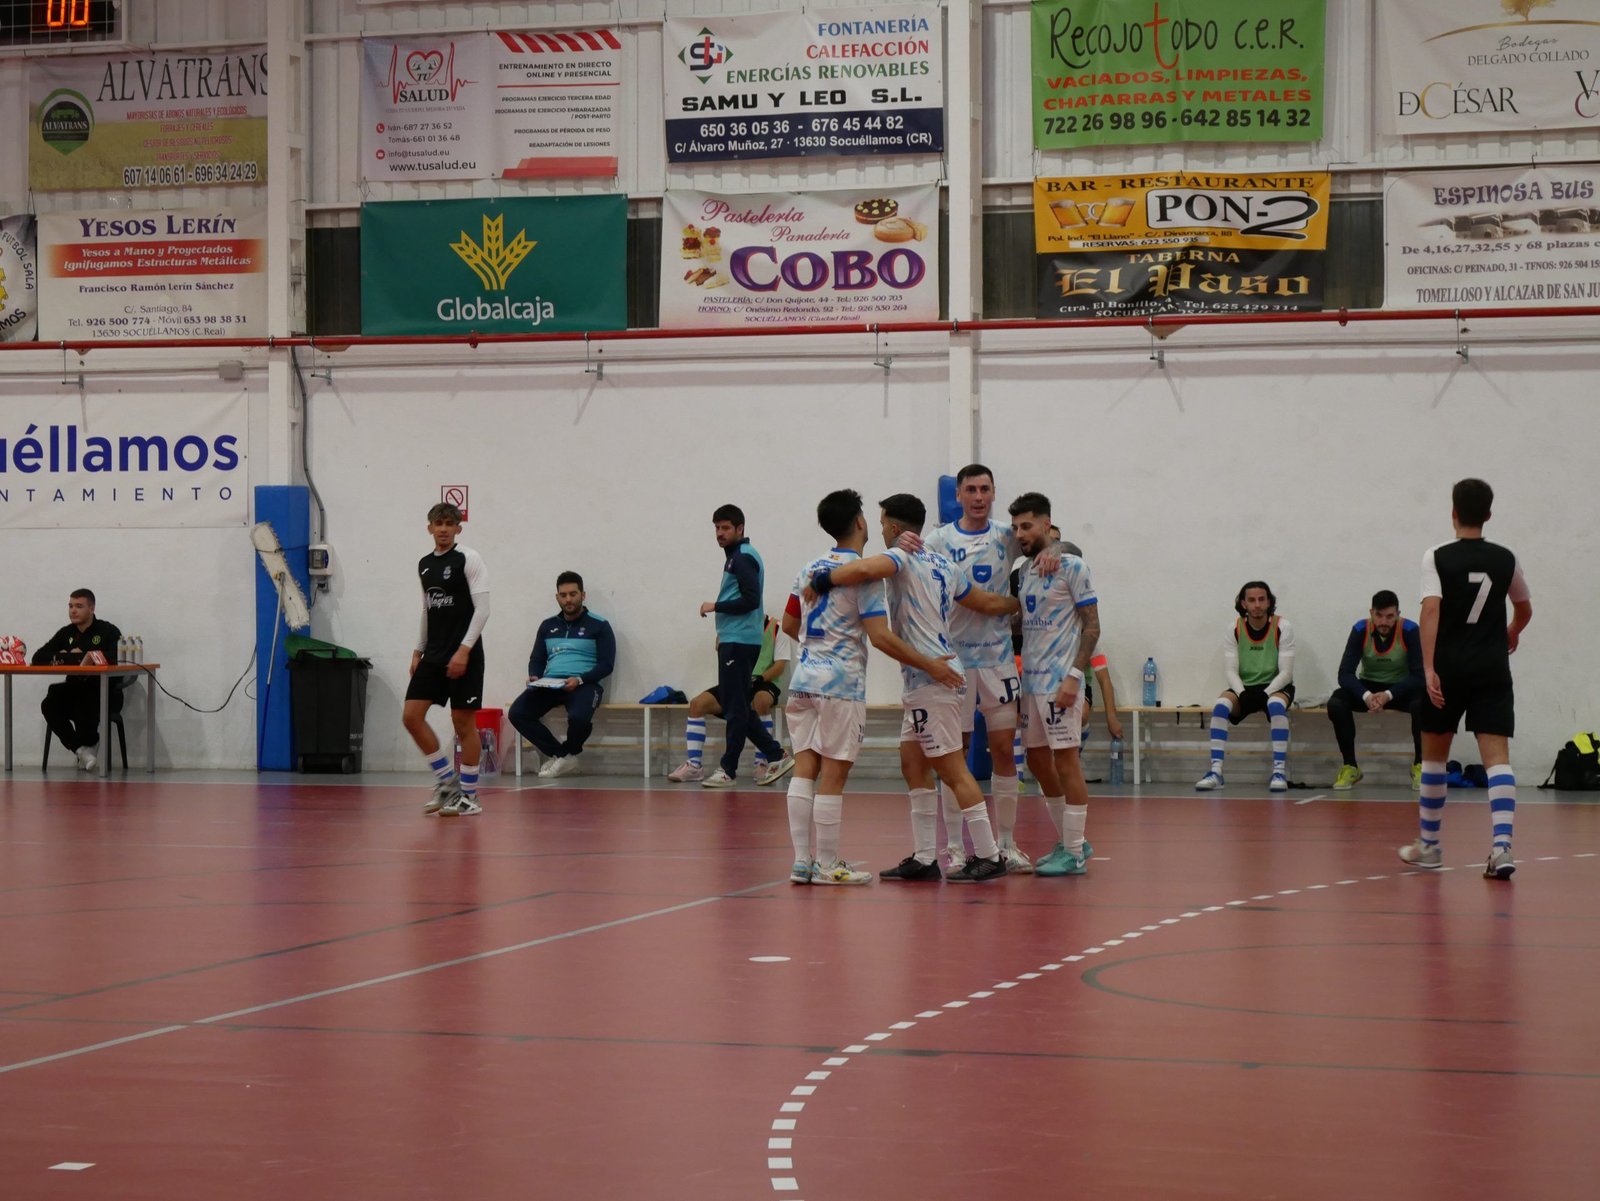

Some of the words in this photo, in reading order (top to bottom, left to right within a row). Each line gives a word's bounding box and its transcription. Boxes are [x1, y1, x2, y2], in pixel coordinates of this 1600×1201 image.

[818, 14, 929, 37] FONTANERÍA
[806, 37, 929, 59] CALEFACCIÓN
[1496, 35, 1559, 51] Bodegas
[1468, 53, 1526, 66] DELGADO
[1529, 50, 1590, 63] COLLADO
[417, 72, 432, 82] TU
[726, 62, 811, 84] ENERGÍAS
[818, 60, 929, 79] RENOVABLES
[1047, 70, 1170, 90] VACIADOS,
[1175, 68, 1309, 82] LIMPIEZAS,
[399, 88, 450, 103] SALUD
[682, 93, 758, 112] SAMU
[768, 92, 785, 108] Y
[799, 89, 847, 106] LEO
[871, 87, 923, 104] S.L.
[1043, 91, 1178, 111] CHATARRAS
[1181, 90, 1196, 102] Y
[1202, 89, 1312, 103] METALES
[44, 120, 88, 130] ALVATRANS
[443, 122, 453, 130] 52
[700, 123, 725, 137] 650
[730, 121, 747, 136] 36
[751, 121, 769, 135] 05
[773, 120, 790, 134] 36
[811, 118, 839, 132] 676
[843, 117, 861, 131] 45
[864, 116, 882, 130] 44
[886, 115, 904, 129] 82
[1043, 115, 1077, 135] 722
[1082, 113, 1104, 131] 26
[1109, 111, 1136, 130] 98
[1141, 110, 1167, 129] 96
[1180, 109, 1221, 128] 642
[1226, 109, 1251, 127] 85
[1256, 109, 1281, 127] 14
[1286, 108, 1311, 127] 32
[675, 142, 687, 153] C/
[689, 138, 725, 153] Álvaro
[728, 138, 768, 152] Muñoz,
[771, 137, 783, 149] 27
[793, 136, 826, 148] 13630
[830, 133, 903, 147] Socuéllamos
[906, 132, 933, 146] (CR)
[388, 149, 450, 158] info@tusalud.eu
[124, 168, 141, 185] 607
[144, 167, 156, 184] 14
[159, 167, 171, 184] 06
[174, 166, 185, 183] 61
[195, 165, 213, 182] 696
[216, 164, 228, 181] 34
[230, 163, 242, 180] 24
[245, 162, 257, 180] 29
[389, 160, 476, 172] www.tusalud.eu
[1046, 180, 1098, 193] BAR
[1120, 176, 1314, 190] RESTAURANTE
[1433, 181, 1543, 206] ESPINOSA
[1550, 180, 1594, 200] BUS
[700, 198, 805, 225] Pastelería
[1155, 193, 1320, 240] PON-2
[79, 218, 157, 238] YESOS
[166, 213, 237, 235] LERÍN
[769, 225, 851, 243] Panadería
[82, 247, 111, 258] Yesos
[124, 246, 155, 256] Mano
[167, 244, 233, 257] Proyectados
[1082, 240, 1138, 248] RESERVAS:
[1402, 245, 1420, 255] De
[1423, 242, 1511, 254] 4,16,27,32,55
[1526, 240, 1543, 250] 68
[1546, 240, 1590, 251] plazas
[1, 231, 28, 261] FUTBOL
[23, 262, 35, 290] SALA
[63, 258, 134, 271] Ignifugamos
[137, 256, 198, 268] Estructuras
[200, 255, 252, 267] Metálicas
[1128, 250, 1241, 265] TABERNA
[730, 245, 926, 292] COBO
[1407, 265, 1452, 275] OFICINAS:
[1465, 263, 1507, 274] PEINADO,
[1509, 262, 1518, 272] 31
[1525, 260, 1557, 271] TFNOS:
[1559, 260, 1573, 270] 926
[1574, 259, 1588, 269] 504
[79, 282, 127, 294] Francisco
[130, 281, 166, 293] Ramón
[168, 281, 193, 292] Lerín
[195, 280, 235, 291] Sánchez
[1055, 266, 1127, 298] El
[1416, 286, 1483, 304] TOMELLOSO
[1484, 286, 1492, 302] Y
[1494, 284, 1545, 302] ALCAZAR
[1547, 283, 1561, 300] DE
[1563, 282, 1585, 300] SAN
[140, 304, 180, 315] Santiago,
[182, 304, 193, 313] 84
[437, 296, 555, 326] Globalcaja
[783, 305, 821, 313] Redondo,
[1059, 304, 1089, 313] Ctra.
[1184, 300, 1209, 309] Tel.
[1212, 302, 1239, 310] 625
[1243, 302, 1269, 311] 429
[1272, 304, 1299, 312] 314
[67, 318, 83, 327] Tel.
[86, 317, 106, 326] 926
[108, 317, 129, 326] 500
[132, 316, 150, 325] 774
[158, 315, 182, 325] Móvil
[183, 315, 201, 324] 653
[204, 315, 217, 324] 98
[219, 315, 232, 324] 38
[235, 314, 247, 323] 31
[92, 329, 121, 338] 13630
[123, 327, 190, 337] SOCUÉLLAMOS
[0, 423, 239, 473] éllamos
[949, 547, 967, 563] 10
[1465, 572, 1493, 624] 7
[806, 588, 829, 640] 2
